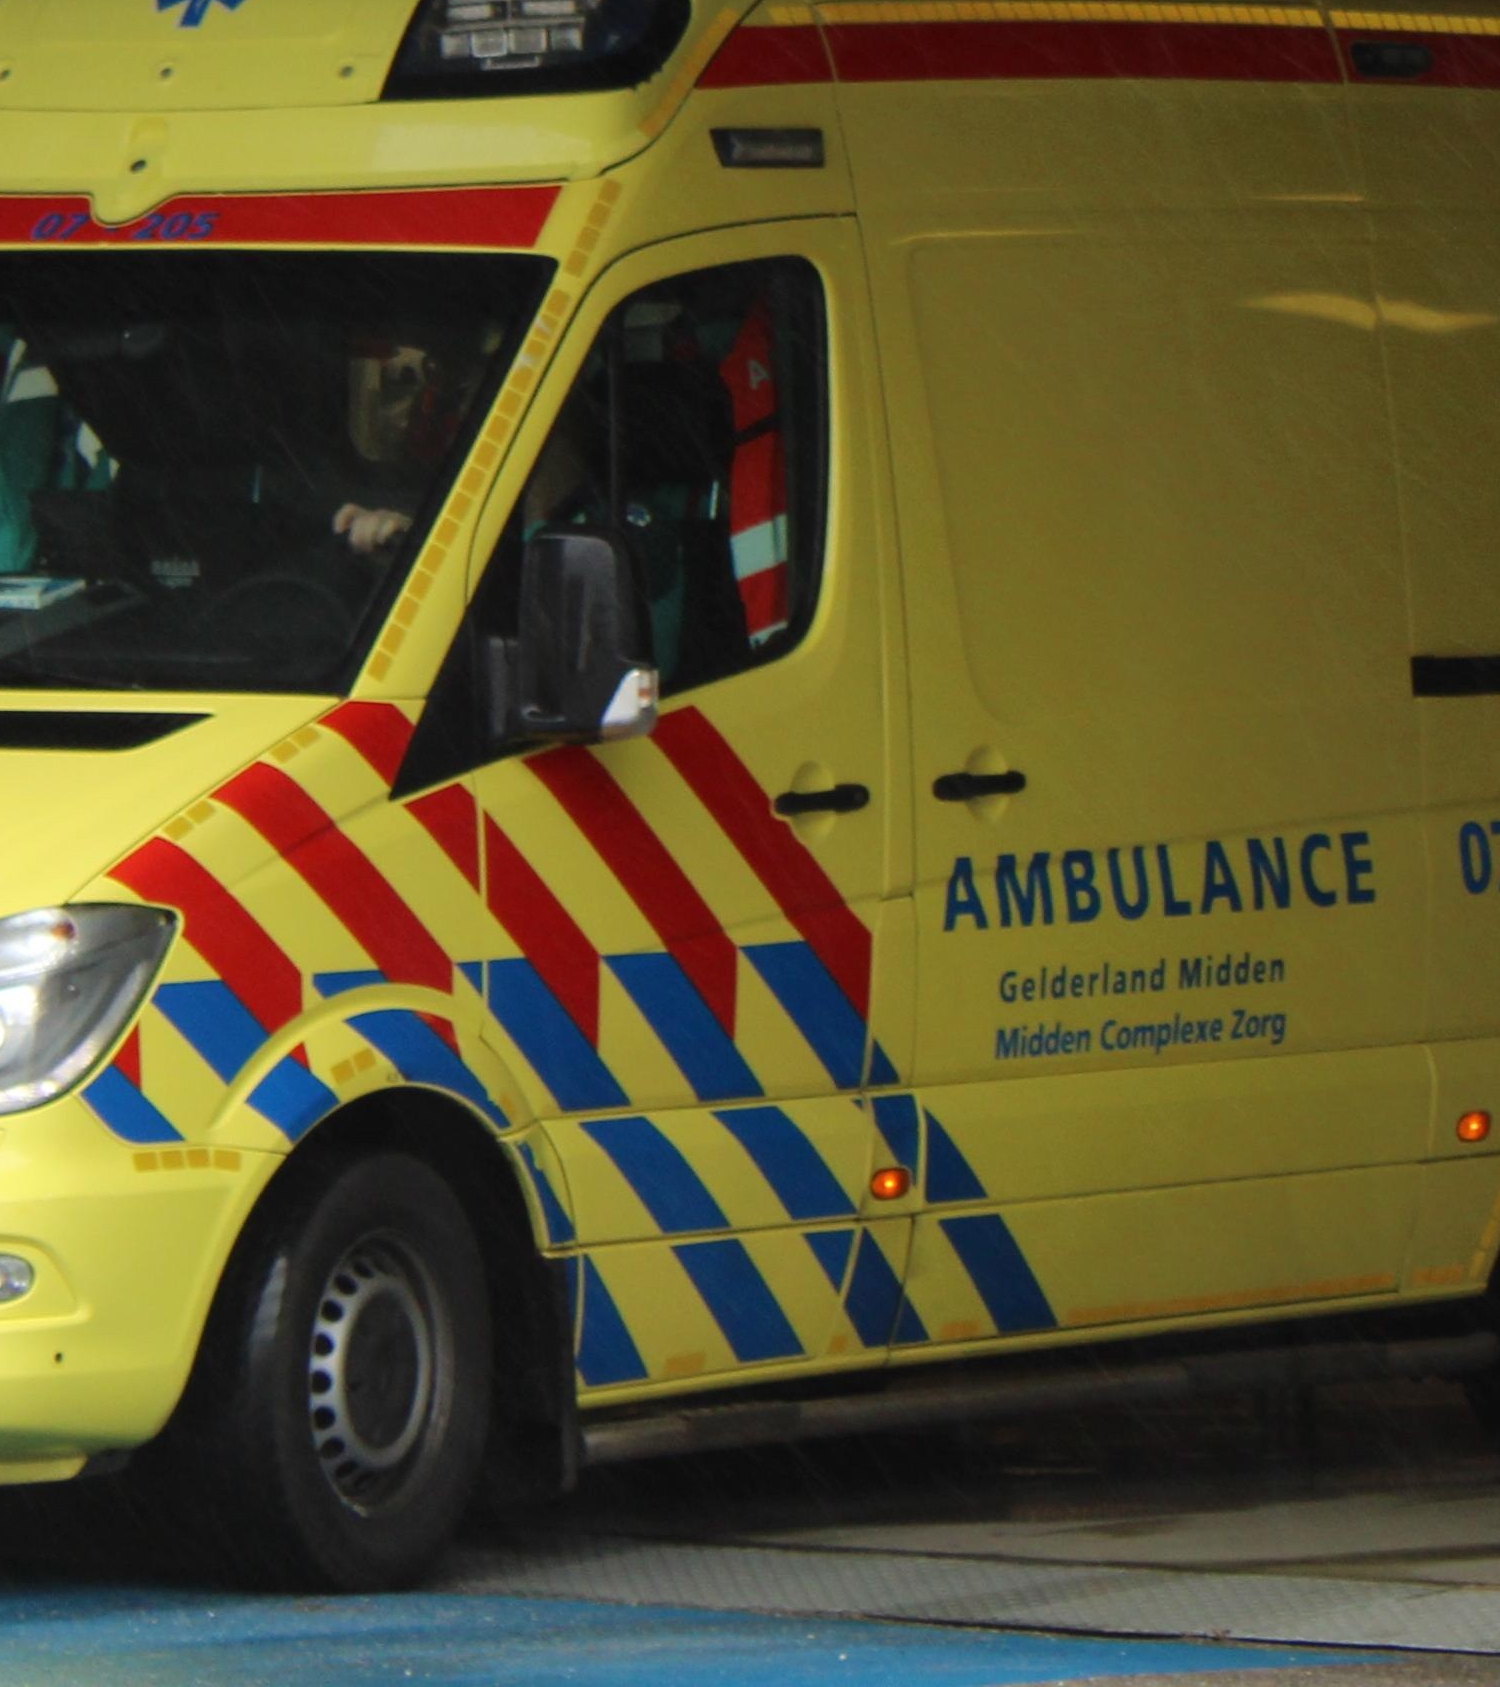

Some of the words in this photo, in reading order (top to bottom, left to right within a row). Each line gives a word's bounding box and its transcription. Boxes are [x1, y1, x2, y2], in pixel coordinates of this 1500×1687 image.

[942, 830, 1377, 933] AMBULANCE
[998, 958, 1167, 1004] Gelderland
[1179, 952, 1286, 990] Midden
[994, 1022, 1092, 1061] Midden
[1100, 1012, 1223, 1055] Complexe
[1230, 1008, 1288, 1048] Zorg
